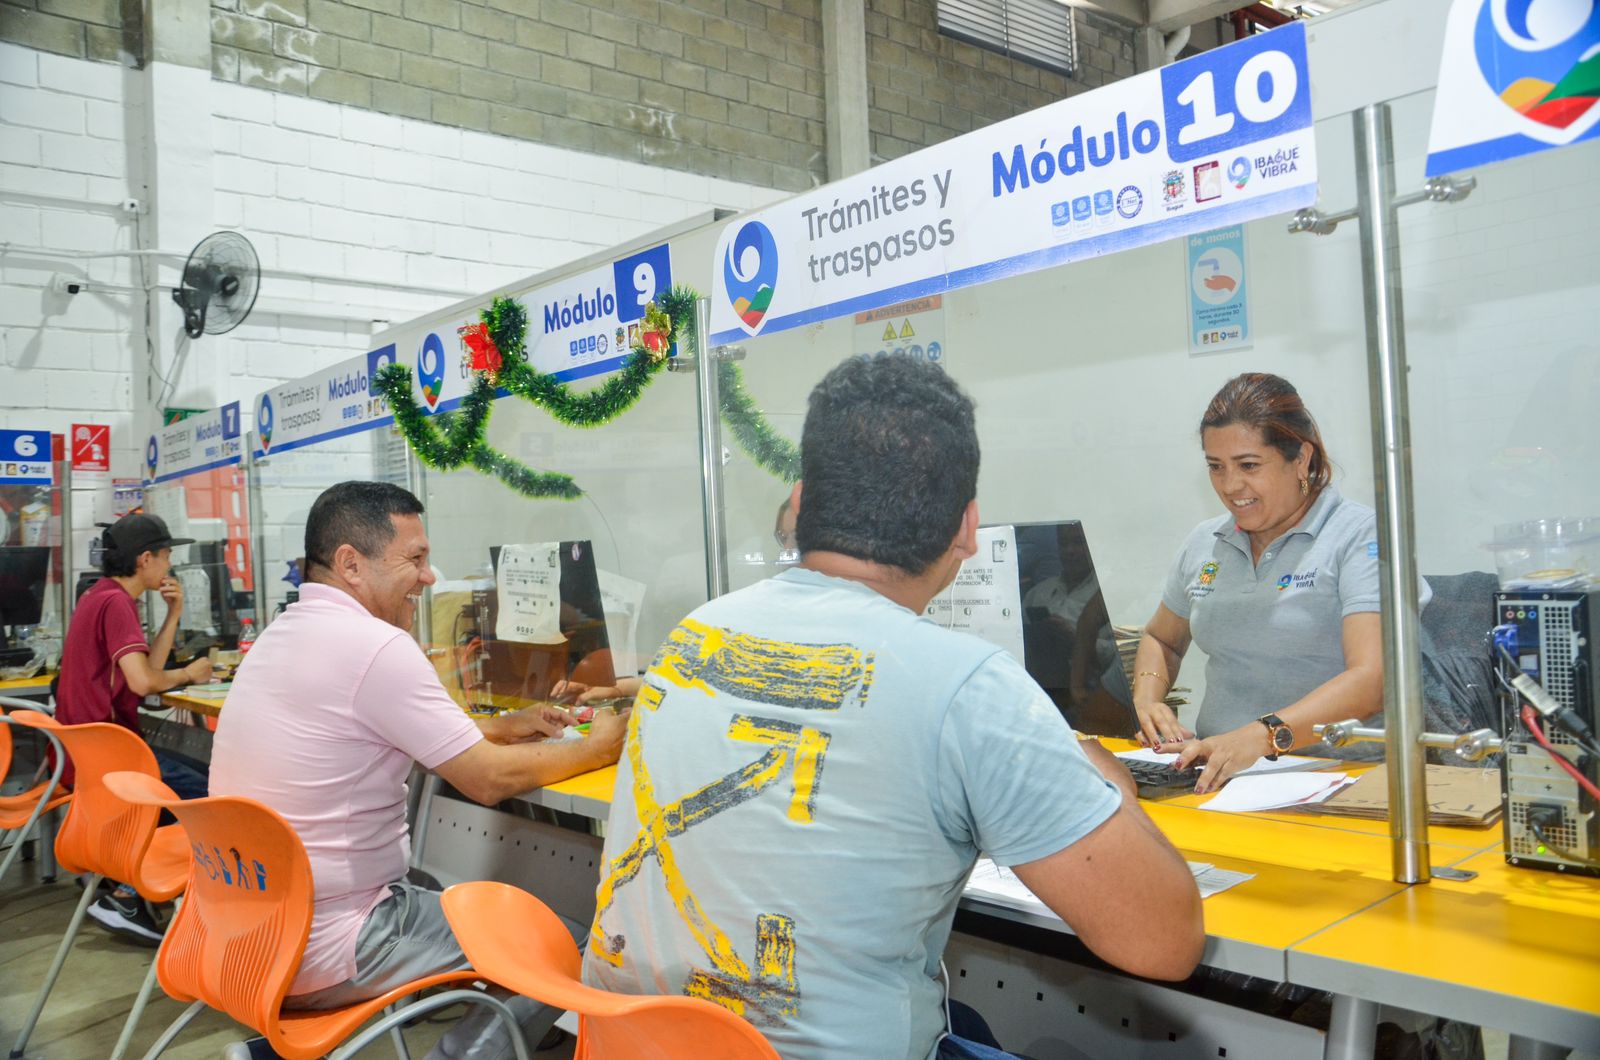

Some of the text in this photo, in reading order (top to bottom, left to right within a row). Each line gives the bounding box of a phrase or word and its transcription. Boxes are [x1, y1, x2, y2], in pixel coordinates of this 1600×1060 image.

[992, 49, 1298, 198] Módulo 10
[1259, 161, 1298, 180] VIBRA
[801, 168, 953, 242] Trámites y
[807, 218, 956, 283] traspasos
[1191, 237, 1203, 247] de
[1206, 231, 1241, 243] manos
[543, 287, 616, 334] Módulo
[632, 262, 657, 305] 9
[876, 299, 931, 318] ADVERTENCIA
[278, 386, 315, 408] Trámites
[328, 370, 368, 401] Módulo
[226, 408, 236, 433] 7
[281, 408, 321, 431] traspasos
[13, 434, 39, 457] 6
